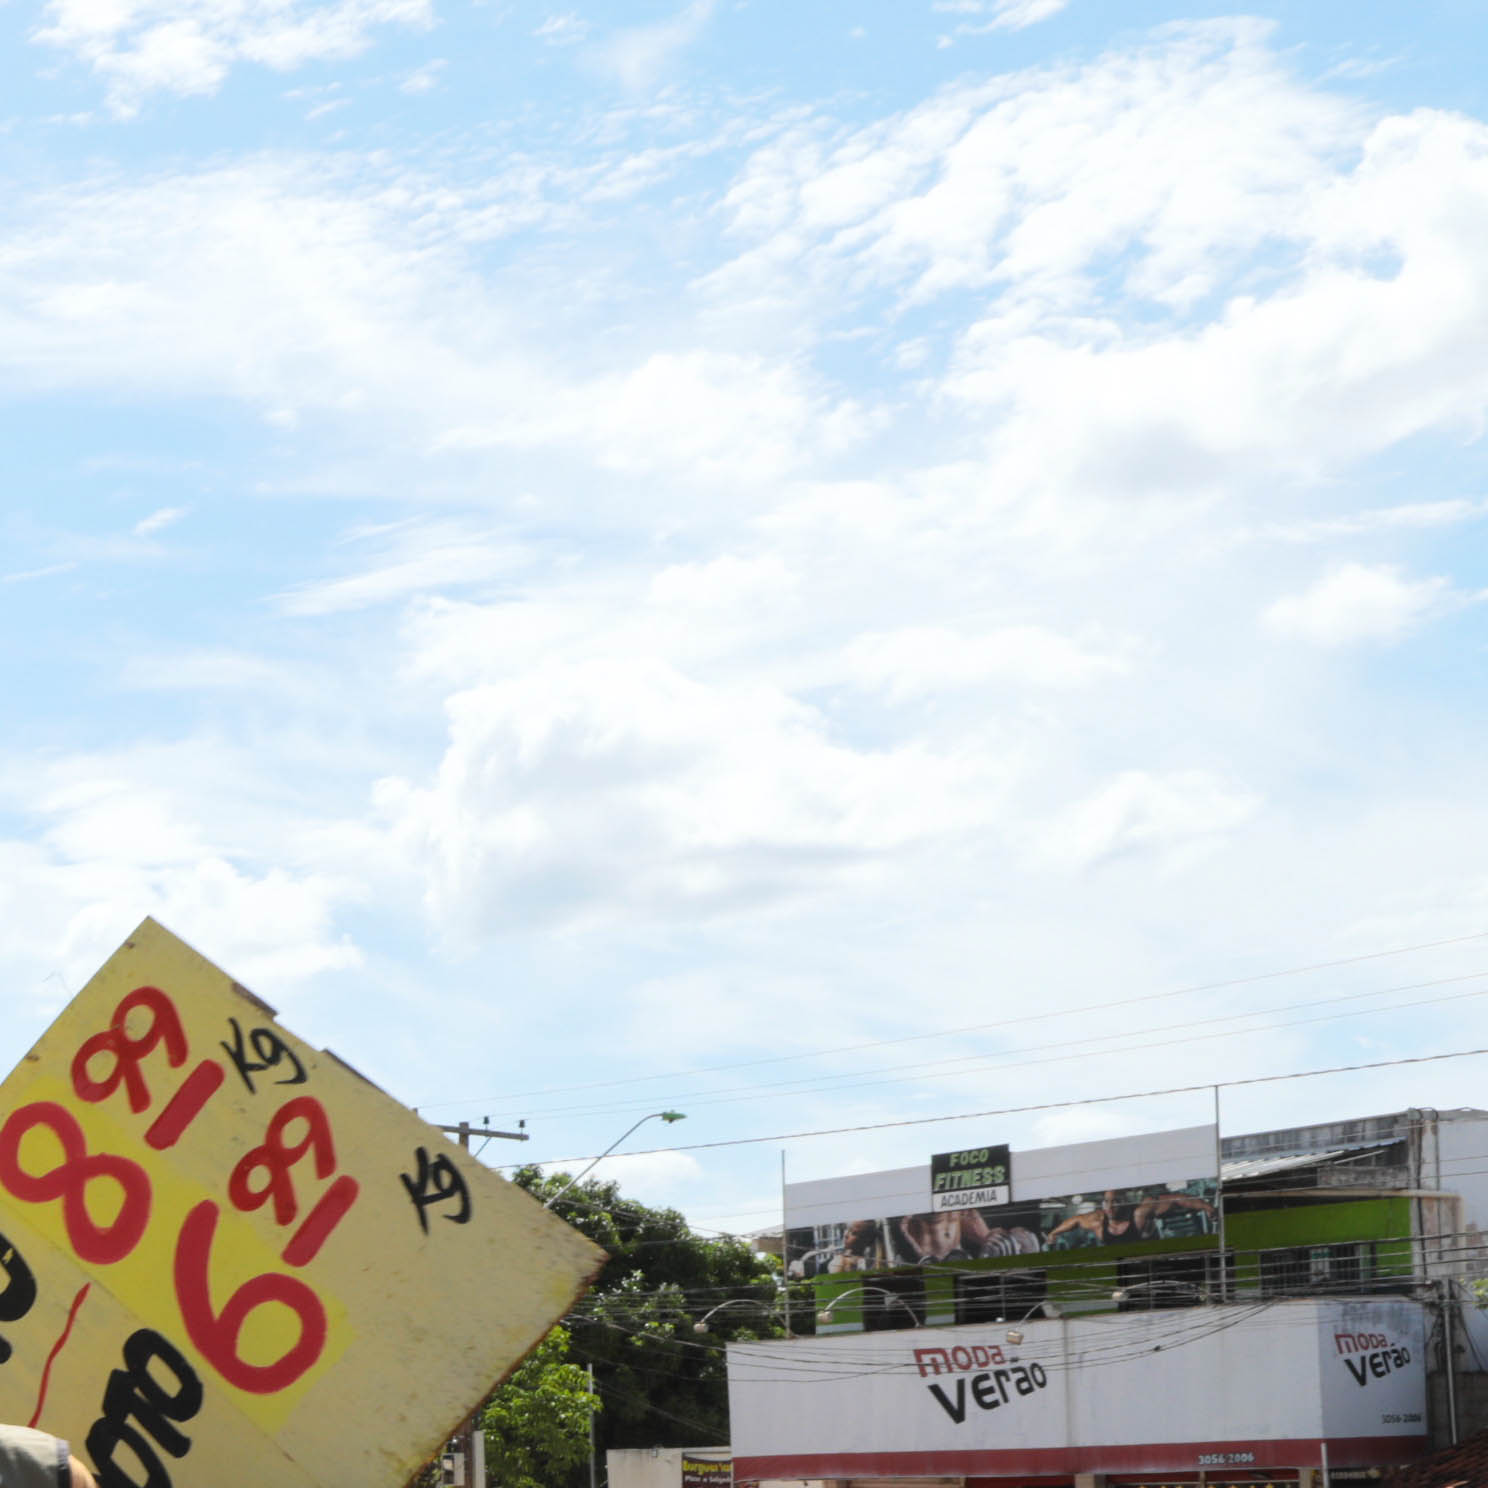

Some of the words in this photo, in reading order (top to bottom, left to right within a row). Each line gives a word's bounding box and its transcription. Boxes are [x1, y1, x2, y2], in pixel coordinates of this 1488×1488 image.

[220, 1016, 310, 1094] Kg
[949, 1149, 990, 1167] FOCO
[399, 1145, 472, 1236] Kg
[934, 1165, 1006, 1191] FITNESS
[941, 1189, 997, 1207] ACADEMIA
